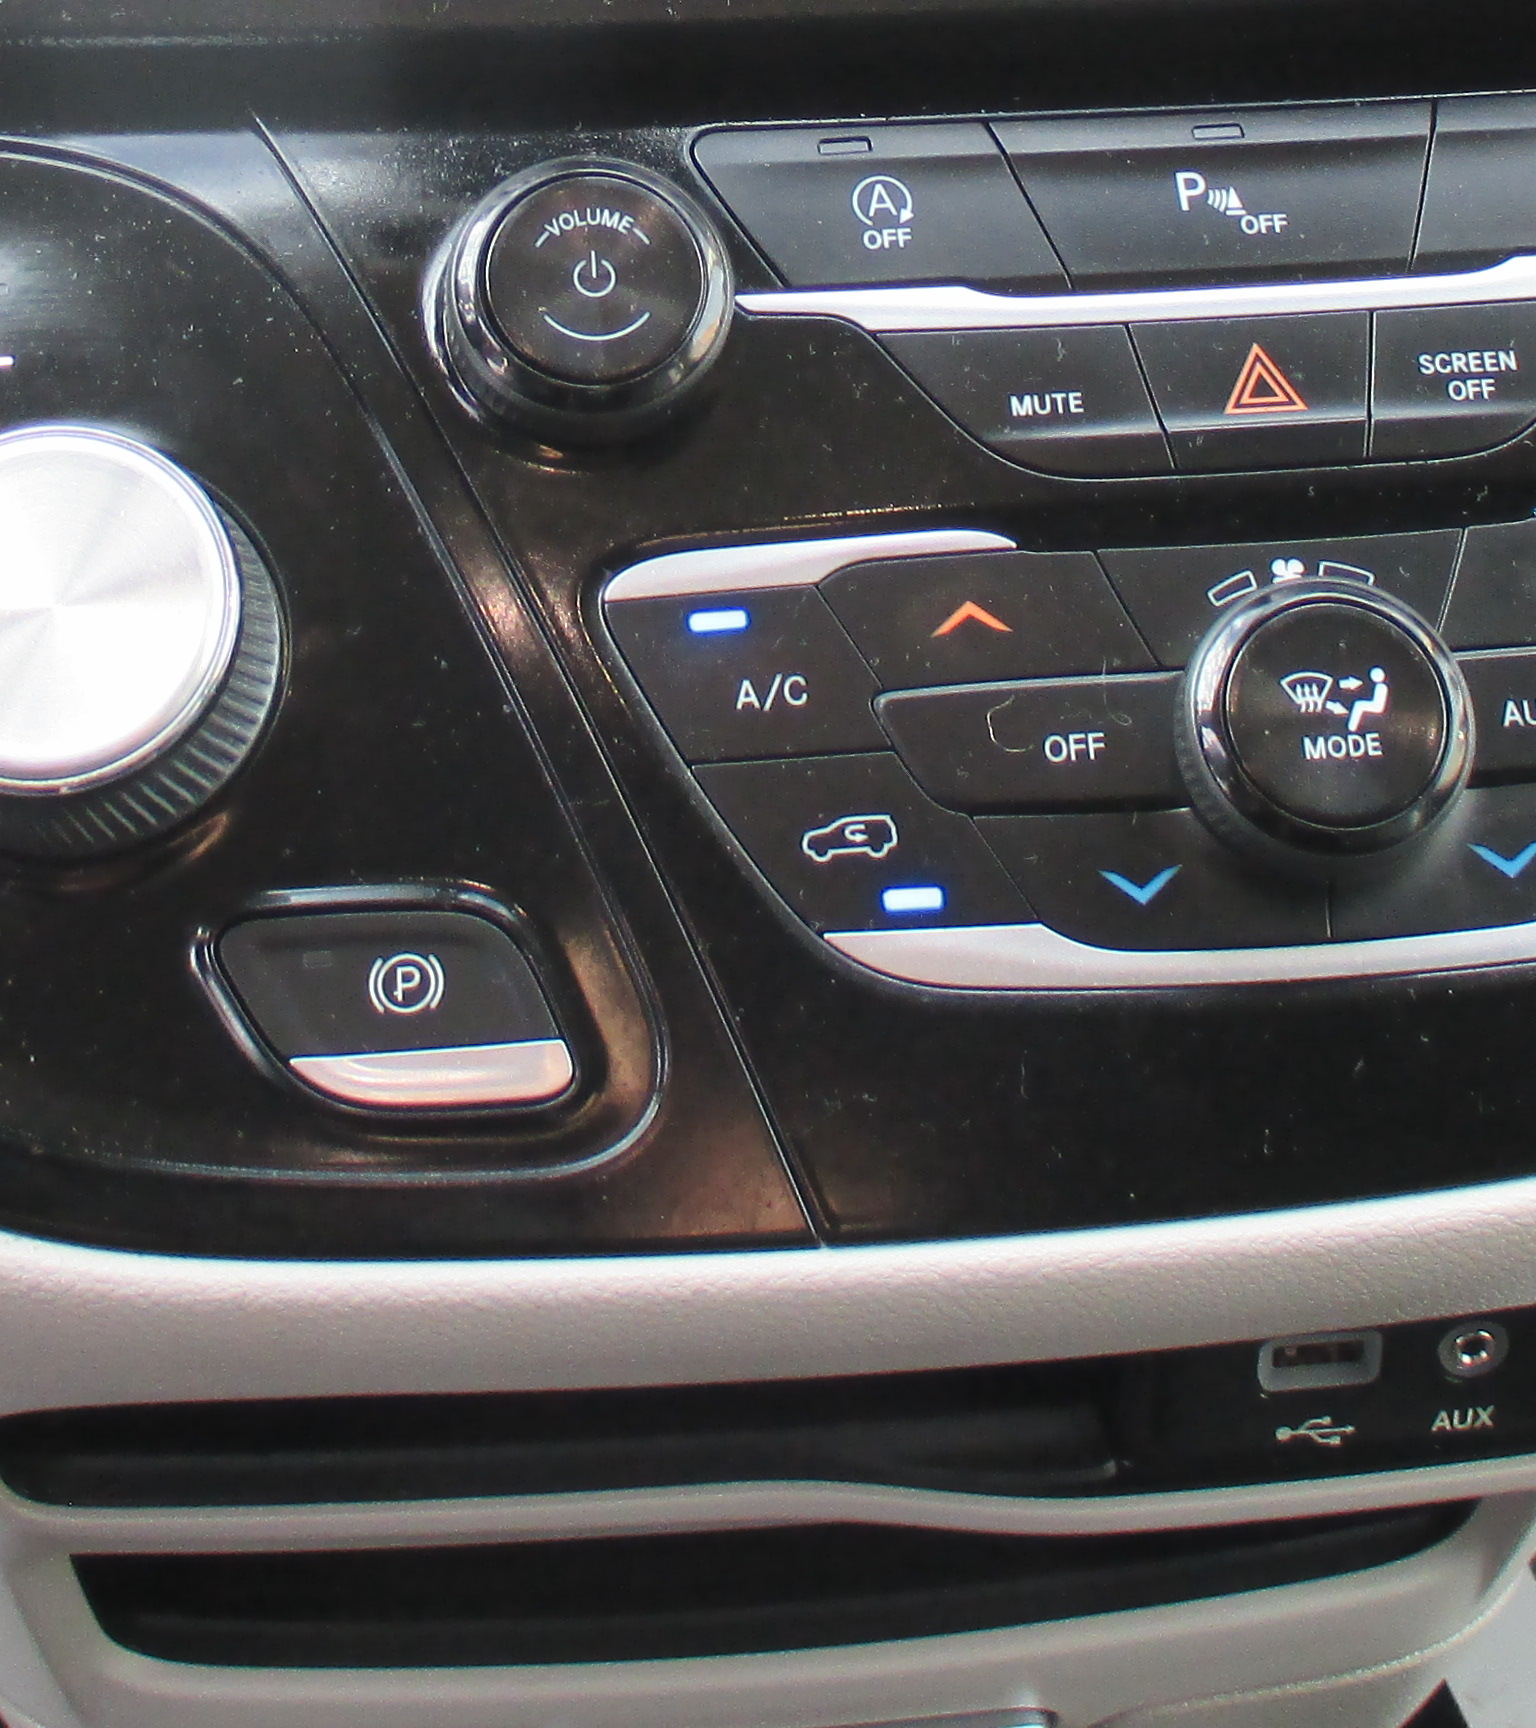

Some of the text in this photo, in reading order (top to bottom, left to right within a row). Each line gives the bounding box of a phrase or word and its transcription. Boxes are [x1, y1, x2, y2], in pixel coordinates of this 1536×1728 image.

[545, 208, 635, 237] VOLUME
[1238, 212, 1288, 235] OFF
[863, 227, 912, 250] OFF
[1418, 350, 1518, 375] SCREEN
[1448, 378, 1496, 401] OFF
[1010, 391, 1084, 417] MUTE
[736, 673, 808, 712] A/C
[1044, 731, 1105, 763] OFF
[1303, 732, 1383, 760] MODE
[1431, 1405, 1494, 1432] AUX
